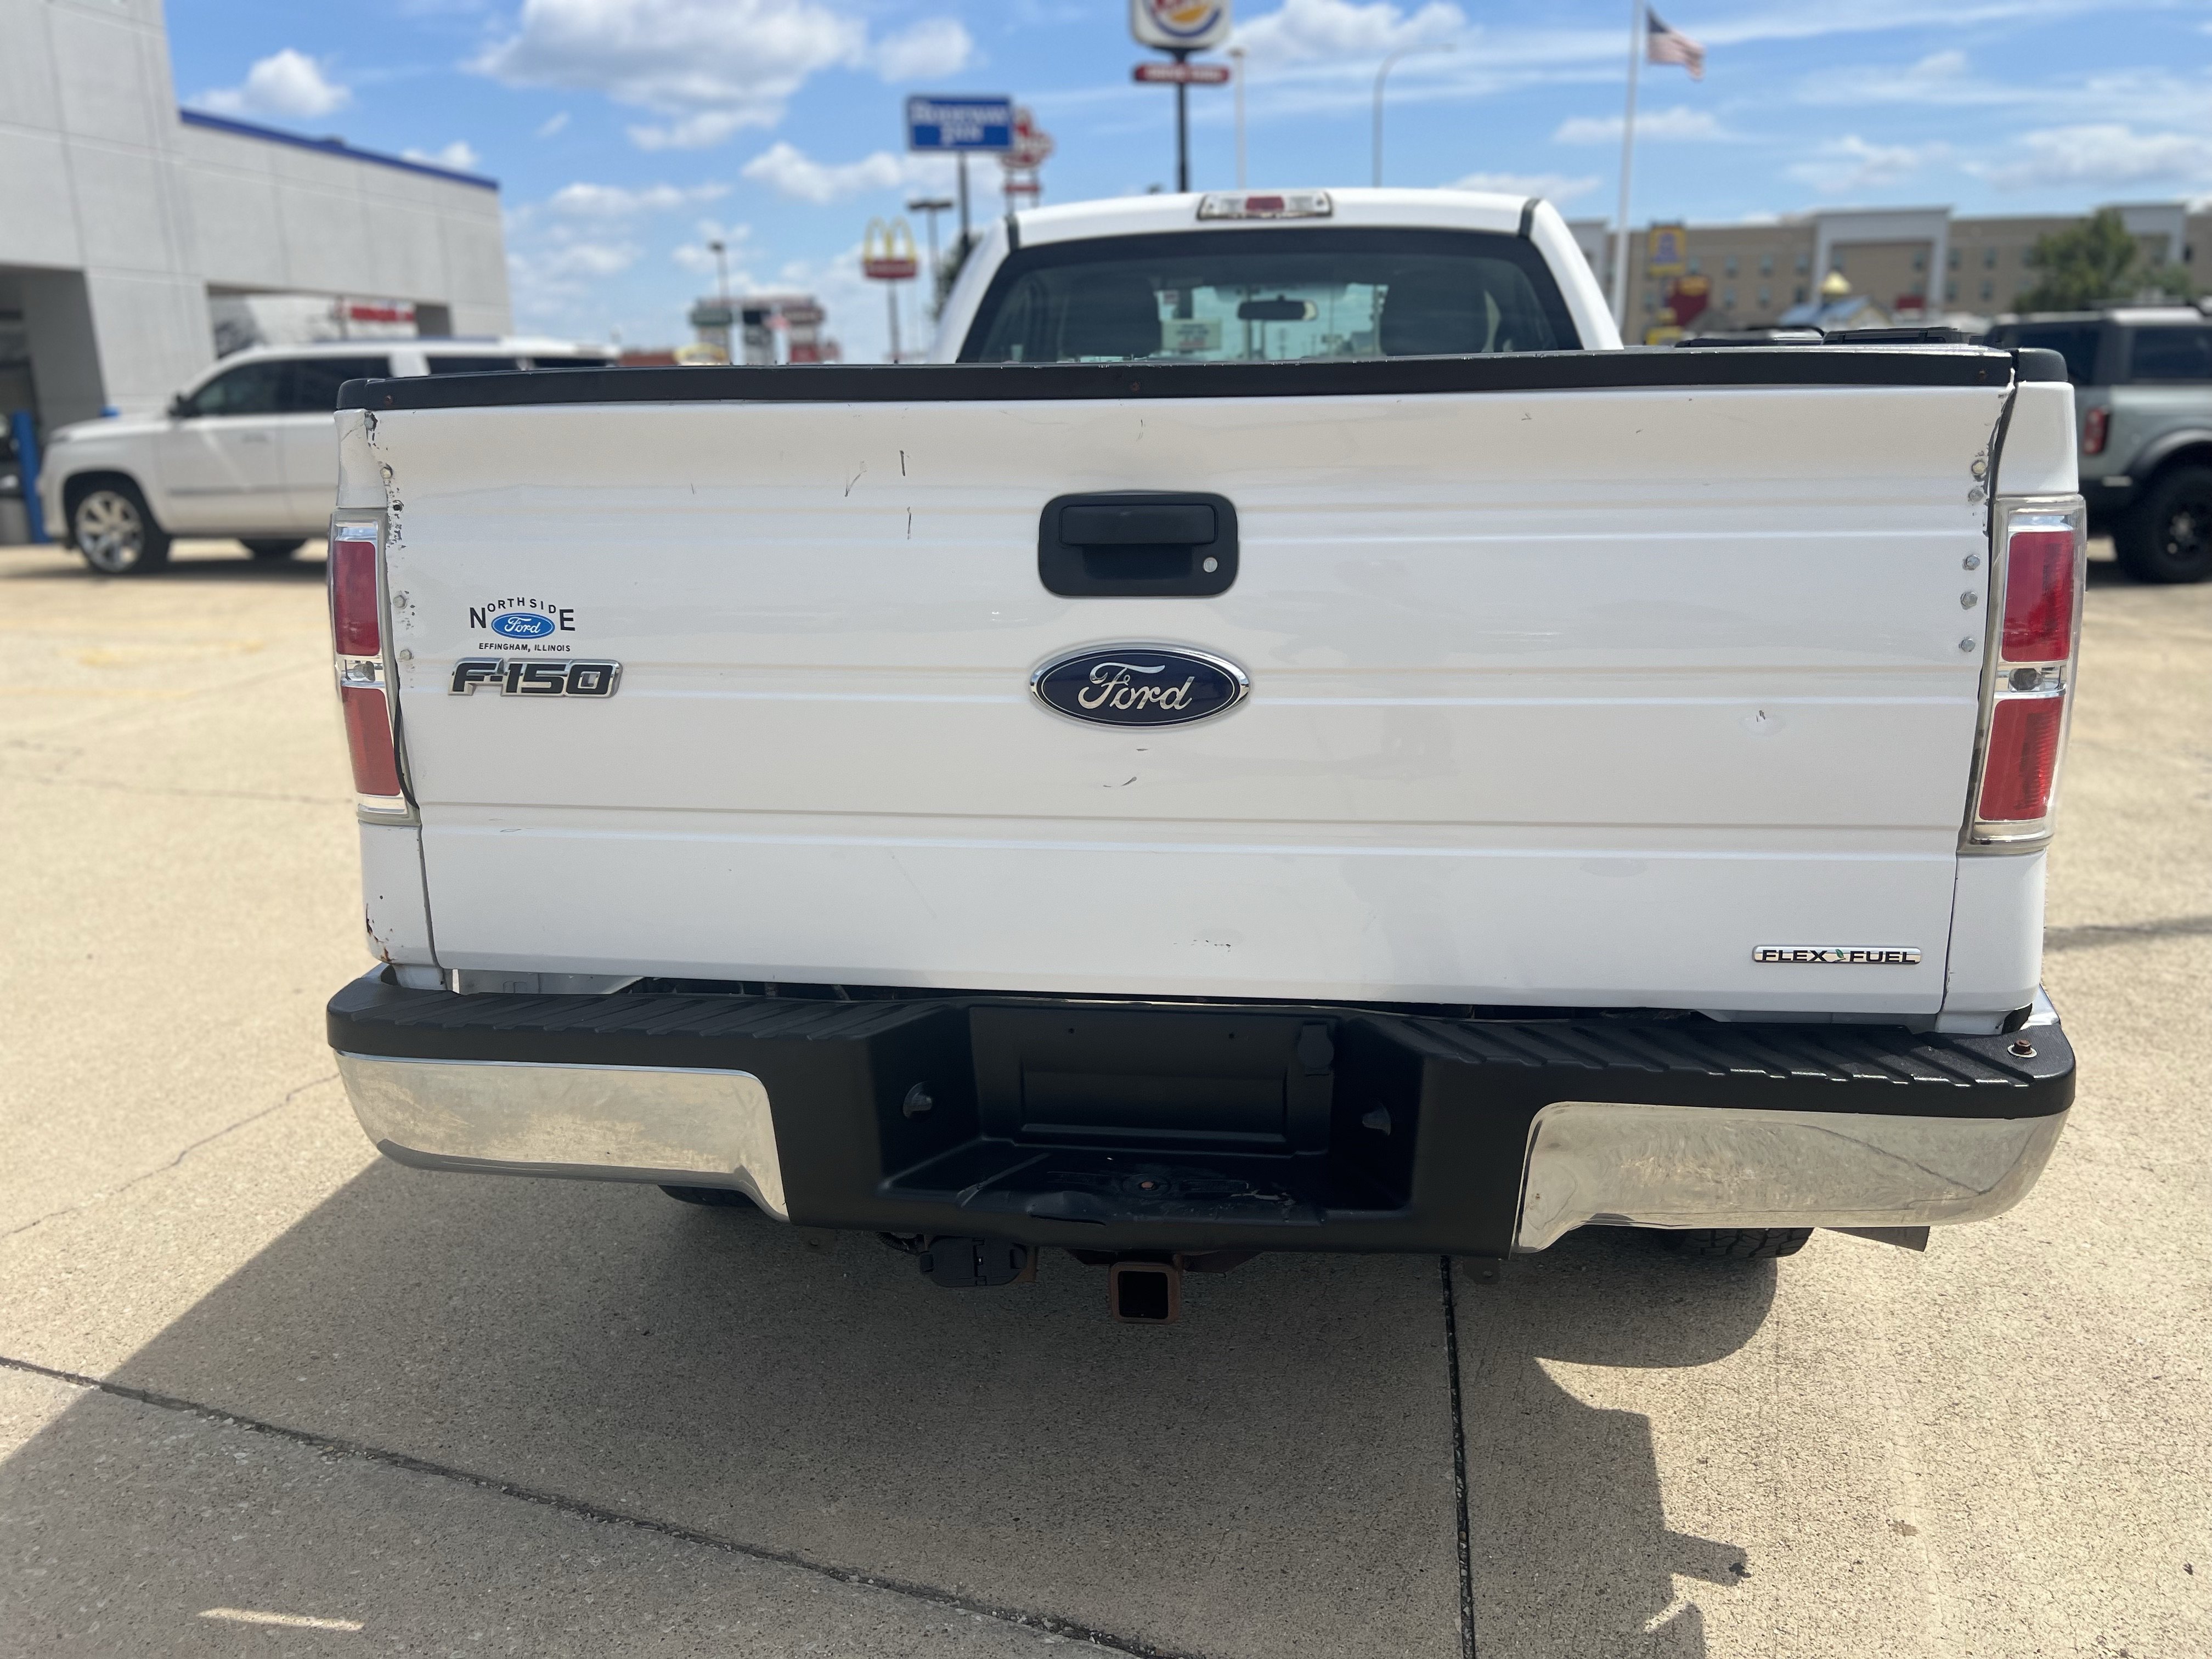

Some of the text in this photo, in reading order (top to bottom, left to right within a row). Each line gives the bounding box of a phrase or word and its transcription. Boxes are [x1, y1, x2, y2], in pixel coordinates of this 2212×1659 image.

[470, 597, 575, 631] NORTHSIDE
[504, 616, 541, 634] Ford
[479, 642, 531, 652] EFFINGHAM,
[447, 657, 623, 698] F-150
[1078, 662, 1195, 710] Ford
[1762, 949, 1916, 963] FLEX FUEL
